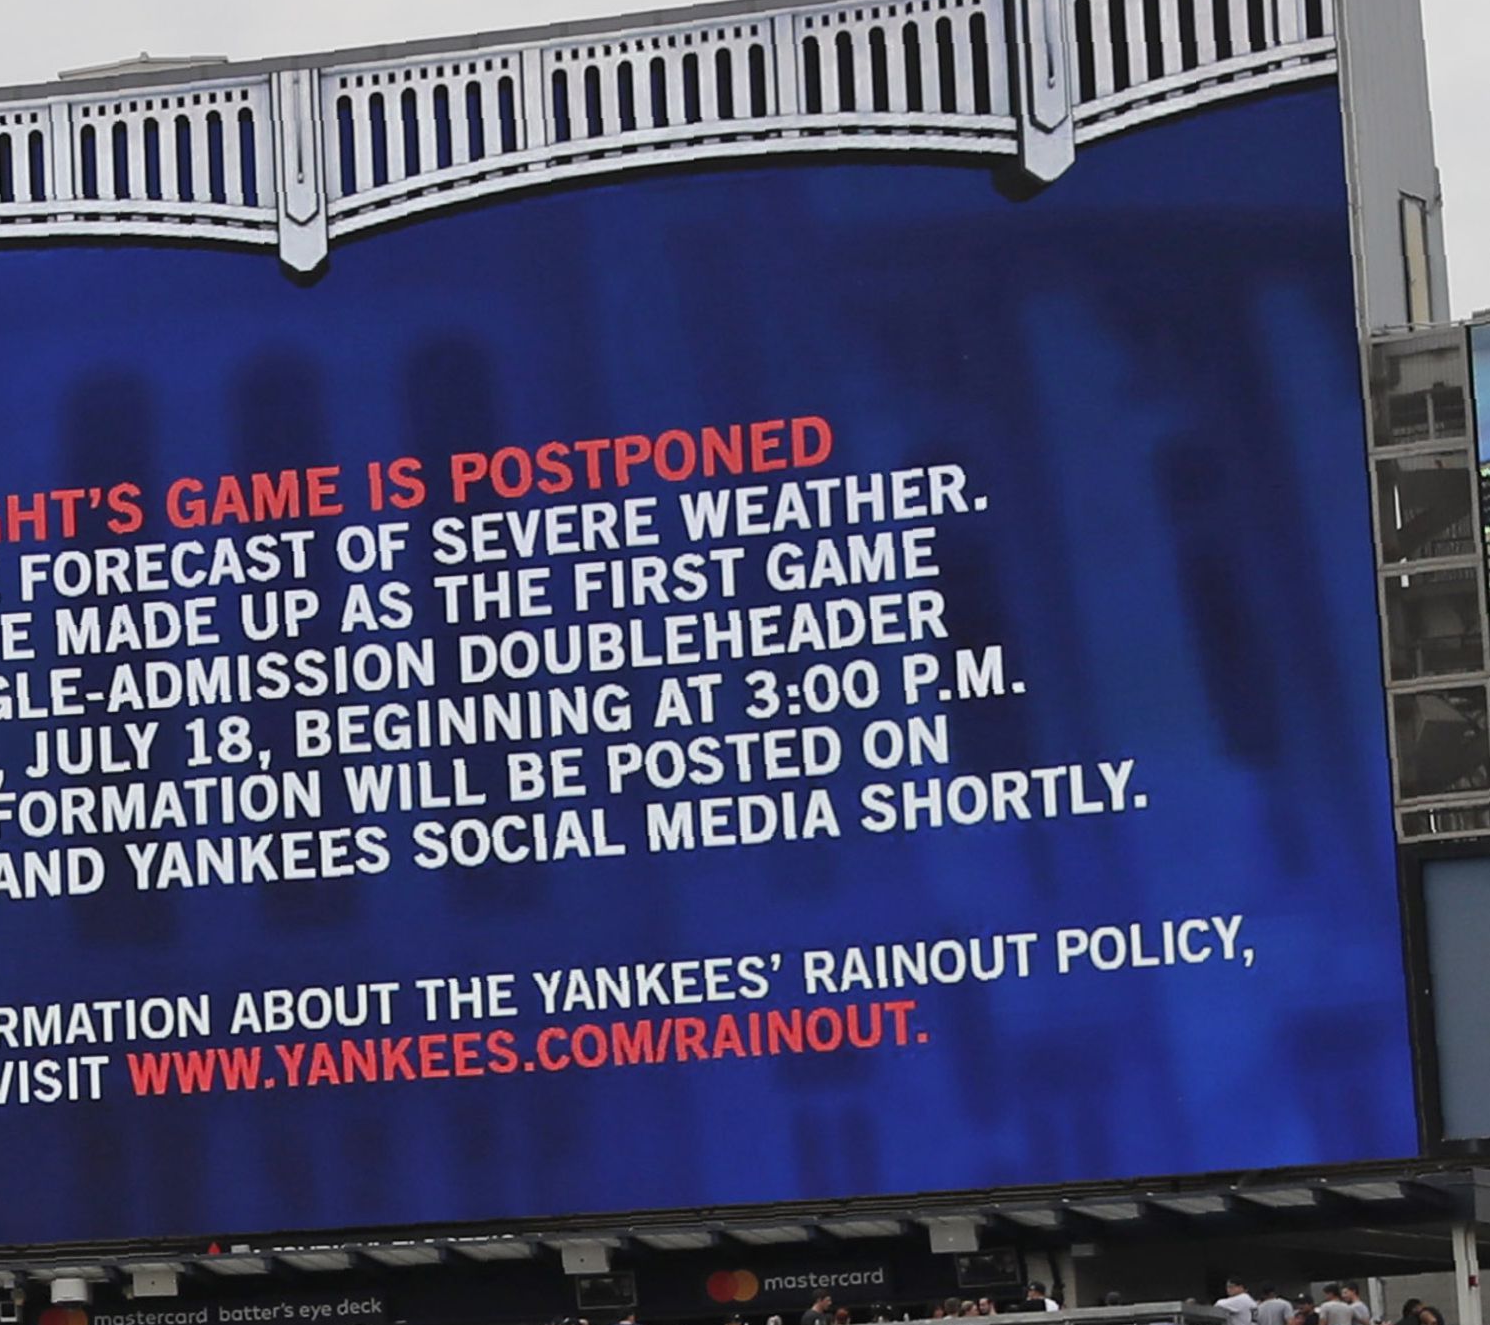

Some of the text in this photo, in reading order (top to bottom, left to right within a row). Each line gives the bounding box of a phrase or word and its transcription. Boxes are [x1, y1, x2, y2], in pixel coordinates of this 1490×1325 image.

[167, 466, 343, 528] GAME
[369, 458, 425, 510] IS
[452, 417, 832, 502] POSTPONED
[21, 531, 314, 600] FORECAST
[337, 523, 408, 572] OF
[433, 497, 658, 564] SEVERE
[680, 465, 987, 540] WEATHER.
[460, 590, 948, 683] DOUBLEHEADER
[26, 723, 158, 777] JULY
[186, 716, 270, 770] 18,
[296, 684, 631, 757] BEGINNING
[655, 674, 721, 727] AT
[746, 660, 879, 718] 3:00
[903, 646, 1025, 704] P.M.
[126, 827, 389, 889] YANKEES
[414, 809, 625, 868] SOCIAL
[647, 790, 840, 851] MEDIA
[862, 760, 1146, 831] SHORTLY.
[231, 983, 399, 1033] ABOUT
[416, 975, 517, 1020] THE
[533, 954, 780, 1013] YANKEES'
[805, 933, 1037, 993] RAINOUT
[1057, 916, 1253, 972] POLICY,
[127, 1001, 927, 1095] WWW.YANKEES.COM/RAINOUT.
[219, 1303, 294, 1321] batter's
[299, 1305, 332, 1321] eye
[337, 1298, 381, 1315] deck
[765, 1268, 883, 1290] mastercard
